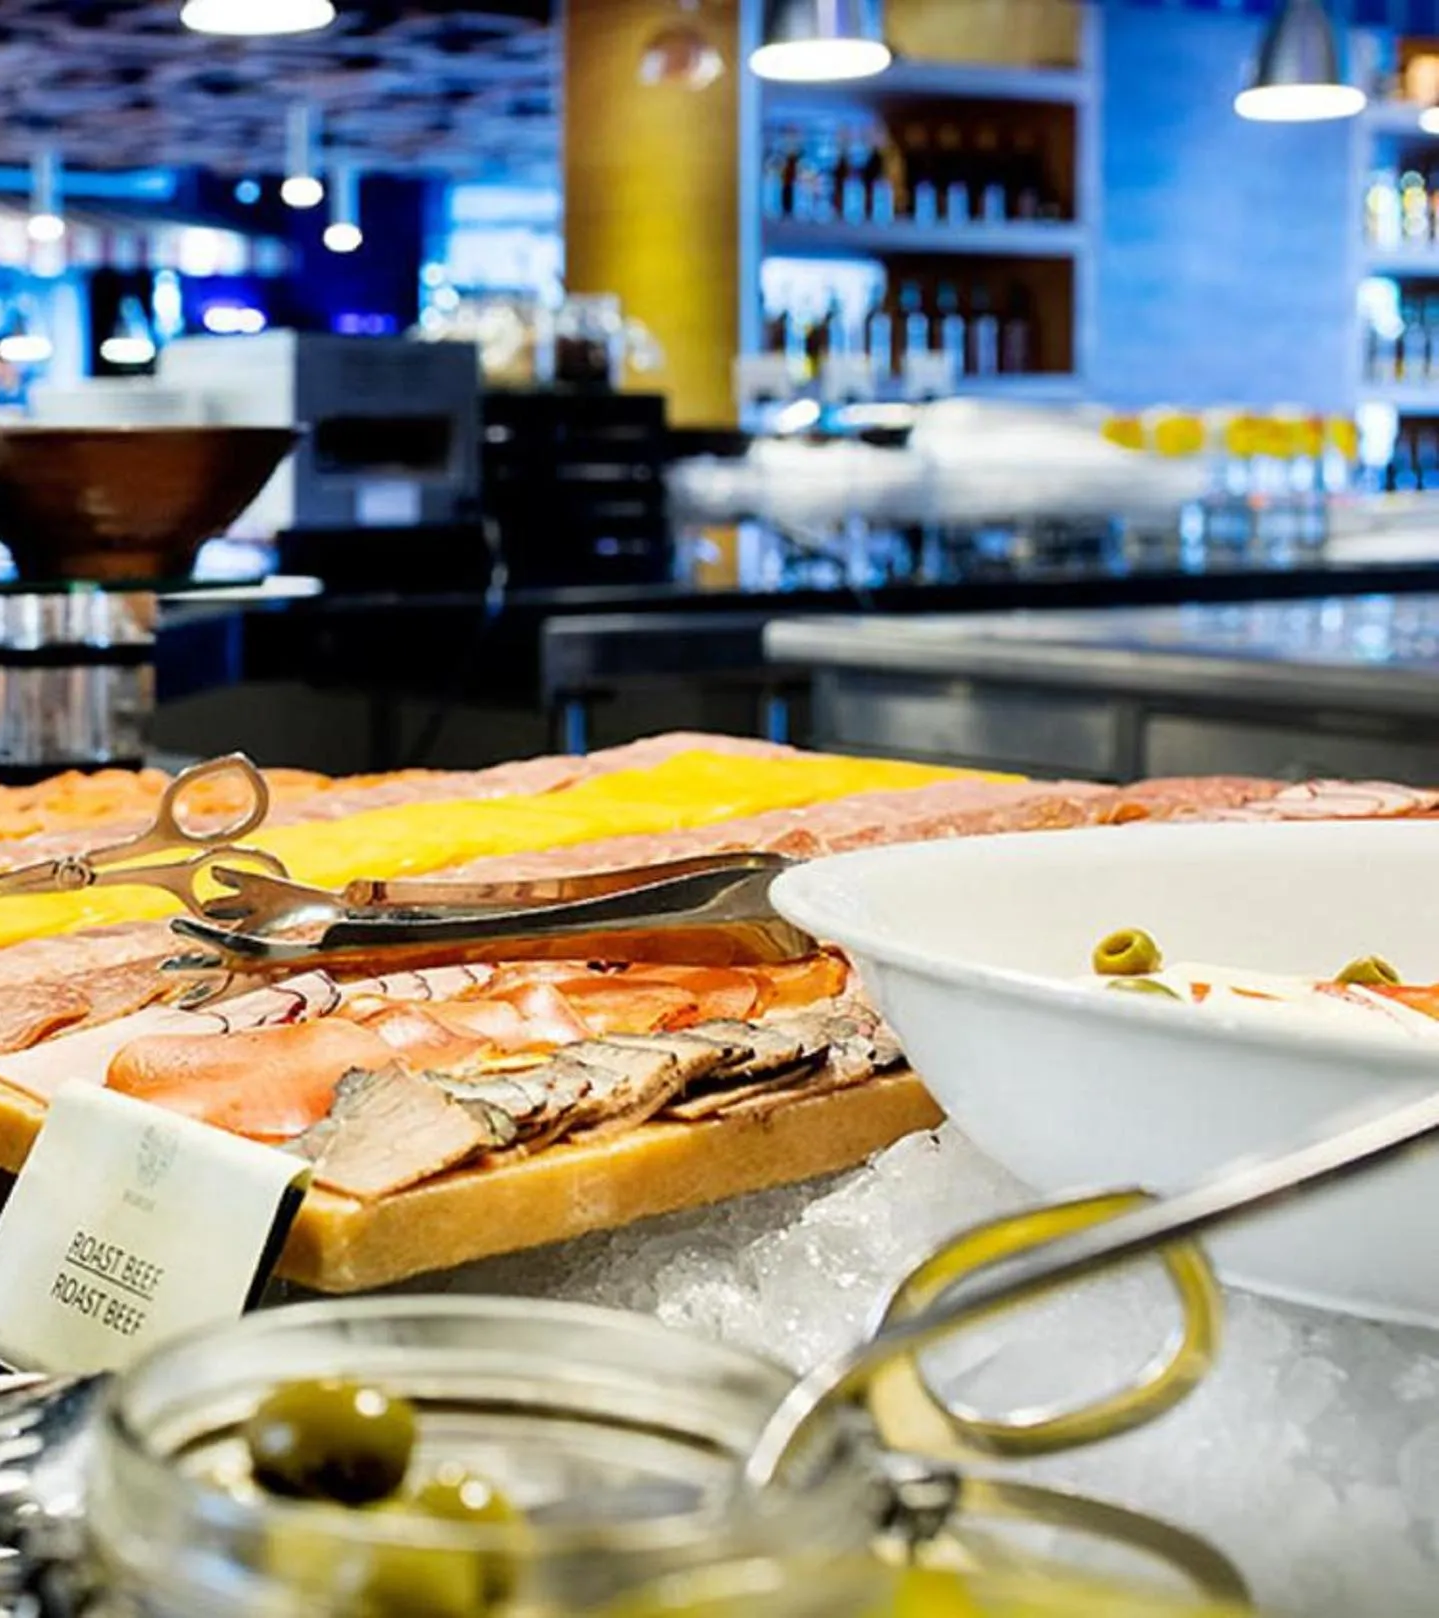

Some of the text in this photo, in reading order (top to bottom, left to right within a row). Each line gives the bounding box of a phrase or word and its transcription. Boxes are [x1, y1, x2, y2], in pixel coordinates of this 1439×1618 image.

[69, 1231, 164, 1291] ROAST BEEF
[51, 1273, 146, 1336] ROAST BEEF
